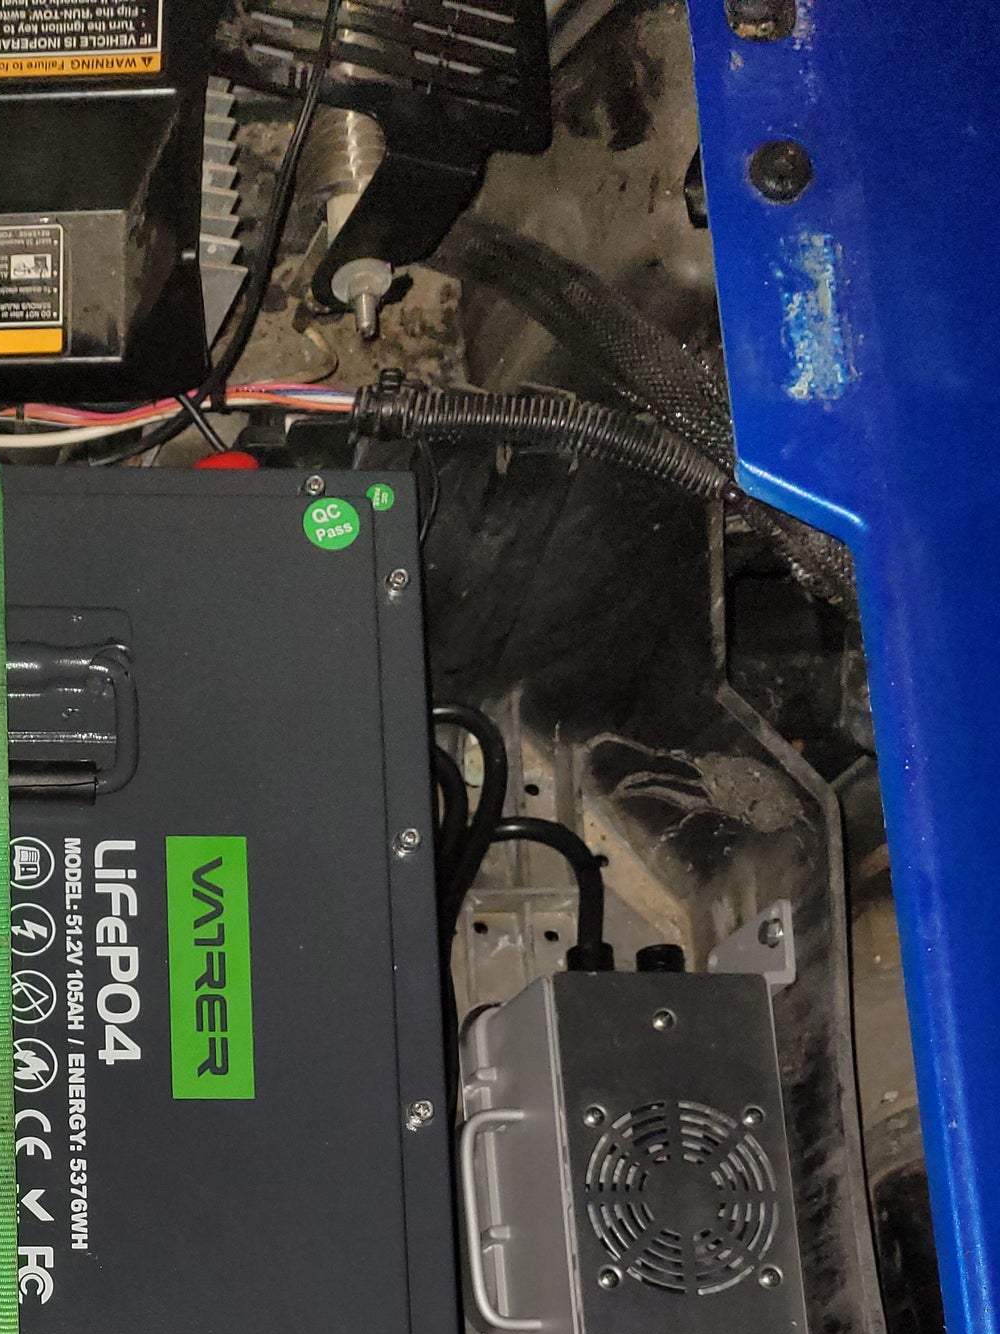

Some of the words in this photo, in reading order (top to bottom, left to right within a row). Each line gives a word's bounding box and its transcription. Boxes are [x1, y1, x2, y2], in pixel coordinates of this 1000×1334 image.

[4, 25, 15, 35] to
[19, 22, 38, 35] key
[42, 21, 84, 34] ignition
[88, 22, 105, 32] the
[110, 21, 134, 32] Turn
[65, 37, 76, 48] IS
[81, 35, 136, 47] VEHICLE
[141, 34, 151, 45] IF
[13, 63, 23, 71] to
[27, 61, 64, 71] Failure
[72, 58, 136, 70] WARNING
[312, 504, 341, 524] QC
[316, 522, 353, 542] Pass
[65, 838, 82, 909] MODEL:
[67, 915, 83, 964] 51.2V
[95, 840, 141, 1064] LiFePO4
[193, 856, 229, 1078] VATRER
[67, 970, 84, 1029] 105AH
[69, 1054, 86, 1150] ENERGY:
[15, 1110, 52, 1160] CE
[71, 1159, 88, 1248] 5376WH
